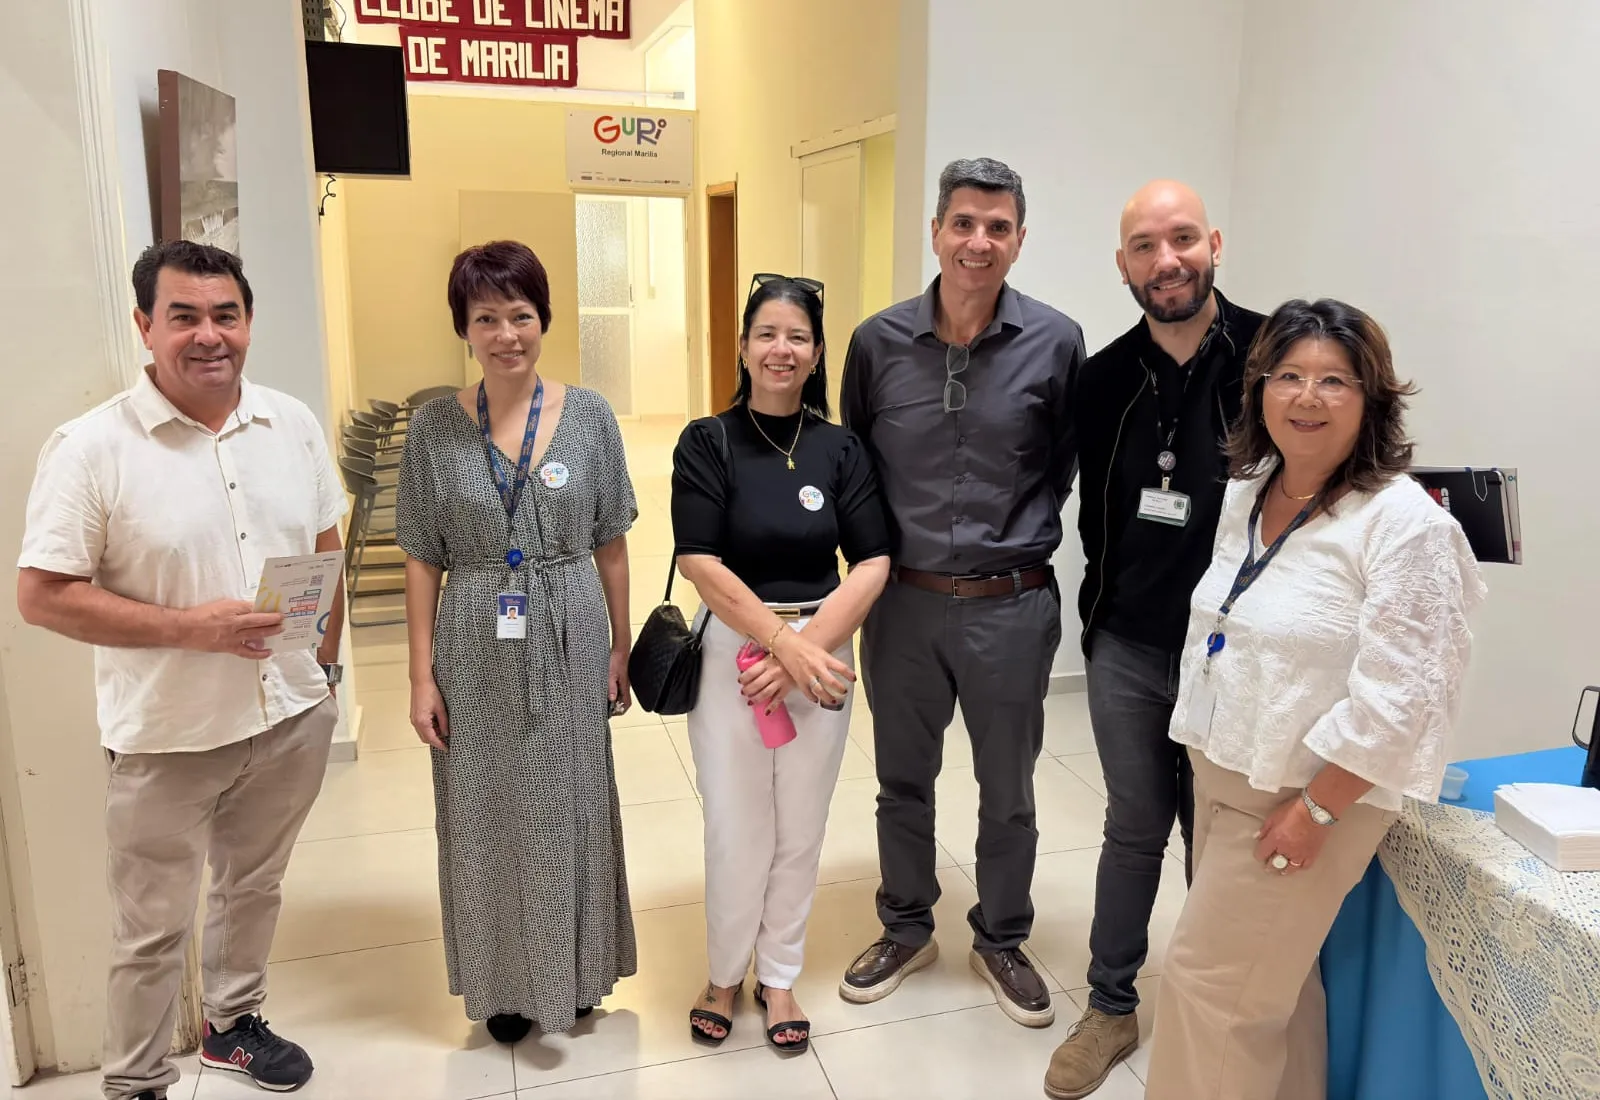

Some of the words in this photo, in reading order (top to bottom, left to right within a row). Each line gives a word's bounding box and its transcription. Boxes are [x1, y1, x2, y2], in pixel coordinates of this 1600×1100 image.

[473, 0, 512, 26] DE
[407, 35, 449, 75] DE
[460, 39, 570, 81] MARILIA
[601, 148, 633, 157] Regional
[229, 1046, 254, 1070] N
